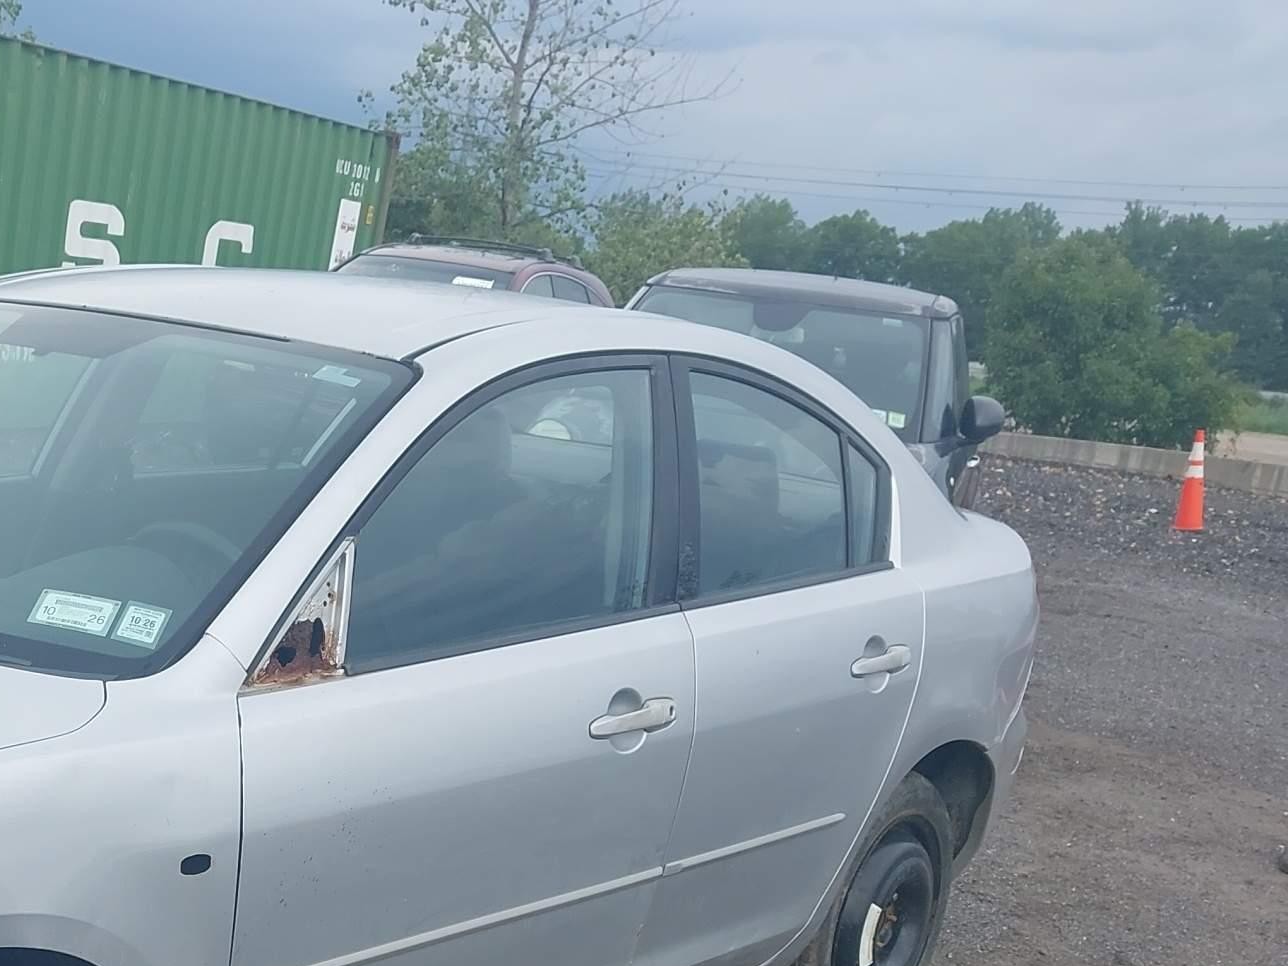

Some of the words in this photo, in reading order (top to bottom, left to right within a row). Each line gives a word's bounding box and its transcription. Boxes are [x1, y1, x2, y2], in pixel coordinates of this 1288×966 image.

[42, 605, 57, 616] 10
[87, 614, 106, 625] 26
[131, 615, 142, 625] 10
[143, 618, 156, 628] 26
